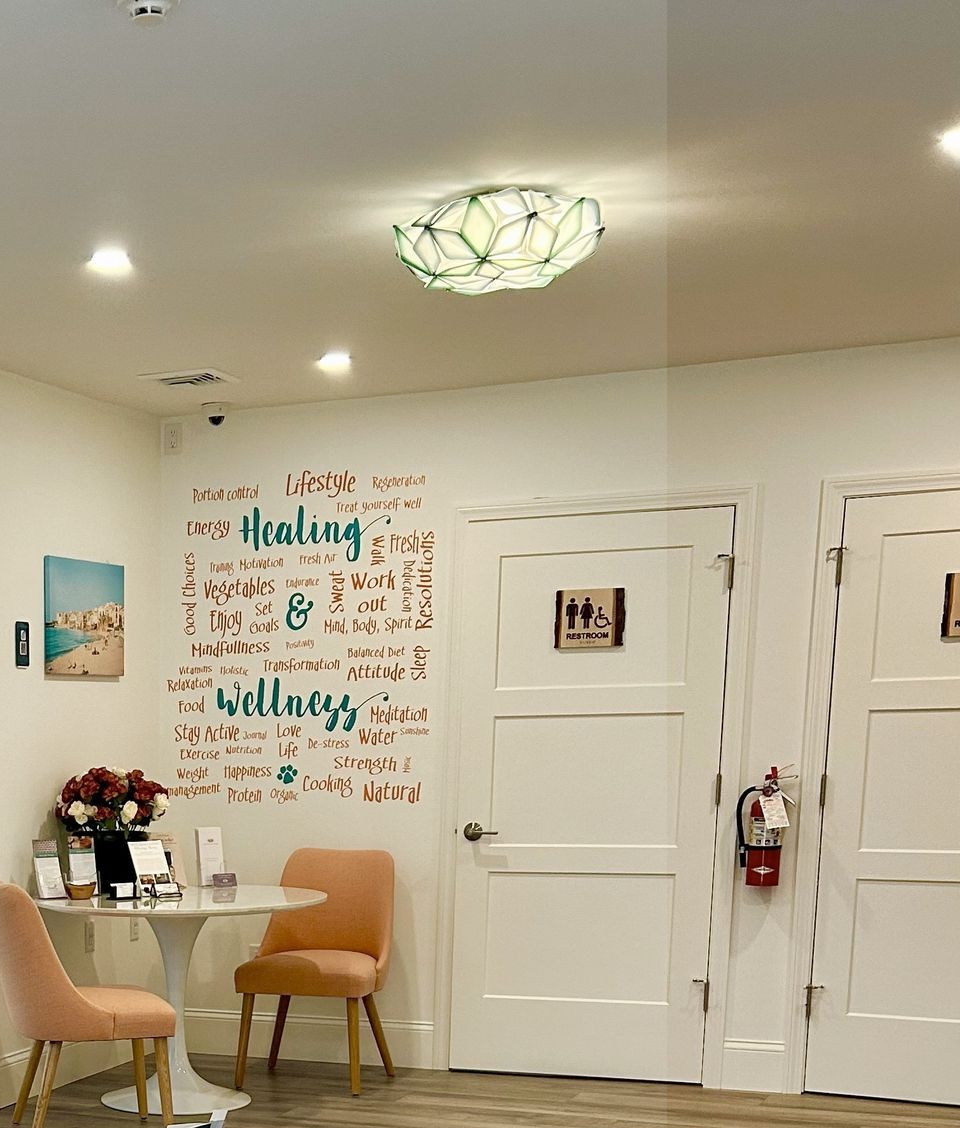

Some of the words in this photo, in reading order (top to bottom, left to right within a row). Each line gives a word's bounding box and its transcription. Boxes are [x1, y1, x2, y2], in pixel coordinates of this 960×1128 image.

[286, 470, 356, 498] Lifestyle
[372, 475, 425, 492] Regeneration
[193, 487, 224, 503] Portion
[227, 484, 259, 501] control
[337, 502, 357, 513] Treat
[360, 497, 400, 514] yourself
[404, 497, 422, 509] well
[187, 520, 230, 540] Energy
[239, 505, 391, 561] Healing
[390, 529, 419, 554] Fresh
[300, 553, 320, 565] Fresh
[324, 554, 338, 564] Air
[371, 535, 385, 566] Walk
[240, 558, 283, 571] Motivation
[182, 552, 196, 596] Choices
[351, 570, 395, 590] Work
[415, 531, 435, 630] Resolutions
[204, 577, 275, 605] Vegetables
[286, 578, 319, 588] Endurance
[329, 570, 345, 613] Sweat
[401, 560, 416, 612] Dedication
[255, 601, 272, 616] Set
[286, 592, 313, 630] &
[358, 595, 387, 613] out
[182, 602, 196, 635] Good
[210, 610, 242, 639] Enjoy
[250, 618, 279, 634] Goals
[324, 618, 348, 634] Mind,
[353, 616, 379, 635] Body,
[385, 616, 412, 634] Spirit
[566, 632, 609, 640] RESTROOM
[192, 640, 270, 658] Mindfullness
[347, 646, 384, 658] Balanced
[388, 646, 405, 657] Diet
[179, 666, 212, 675] Vitamins
[220, 666, 248, 675] Holistic
[264, 658, 340, 673] Transformation
[410, 645, 430, 680] Sleep
[347, 663, 405, 681] Attitude
[167, 677, 212, 692] Relaxation
[179, 696, 205, 713] Food
[371, 705, 428, 724] Meditation
[175, 723, 200, 745] Stay
[205, 723, 240, 742] Active
[277, 723, 302, 738] Love
[359, 728, 398, 745] Water
[226, 745, 262, 755] Nutrition
[279, 742, 298, 759] Life
[308, 738, 349, 749] De-stress
[181, 749, 220, 760] Exercise
[224, 765, 272, 781] Happiness
[334, 756, 396, 775] Strength
[177, 767, 208, 783] Weight
[167, 783, 221, 799] management
[303, 774, 352, 797] Cooking
[364, 781, 421, 804] Natural
[228, 788, 261, 803] Protein
[270, 789, 299, 804] Organic
